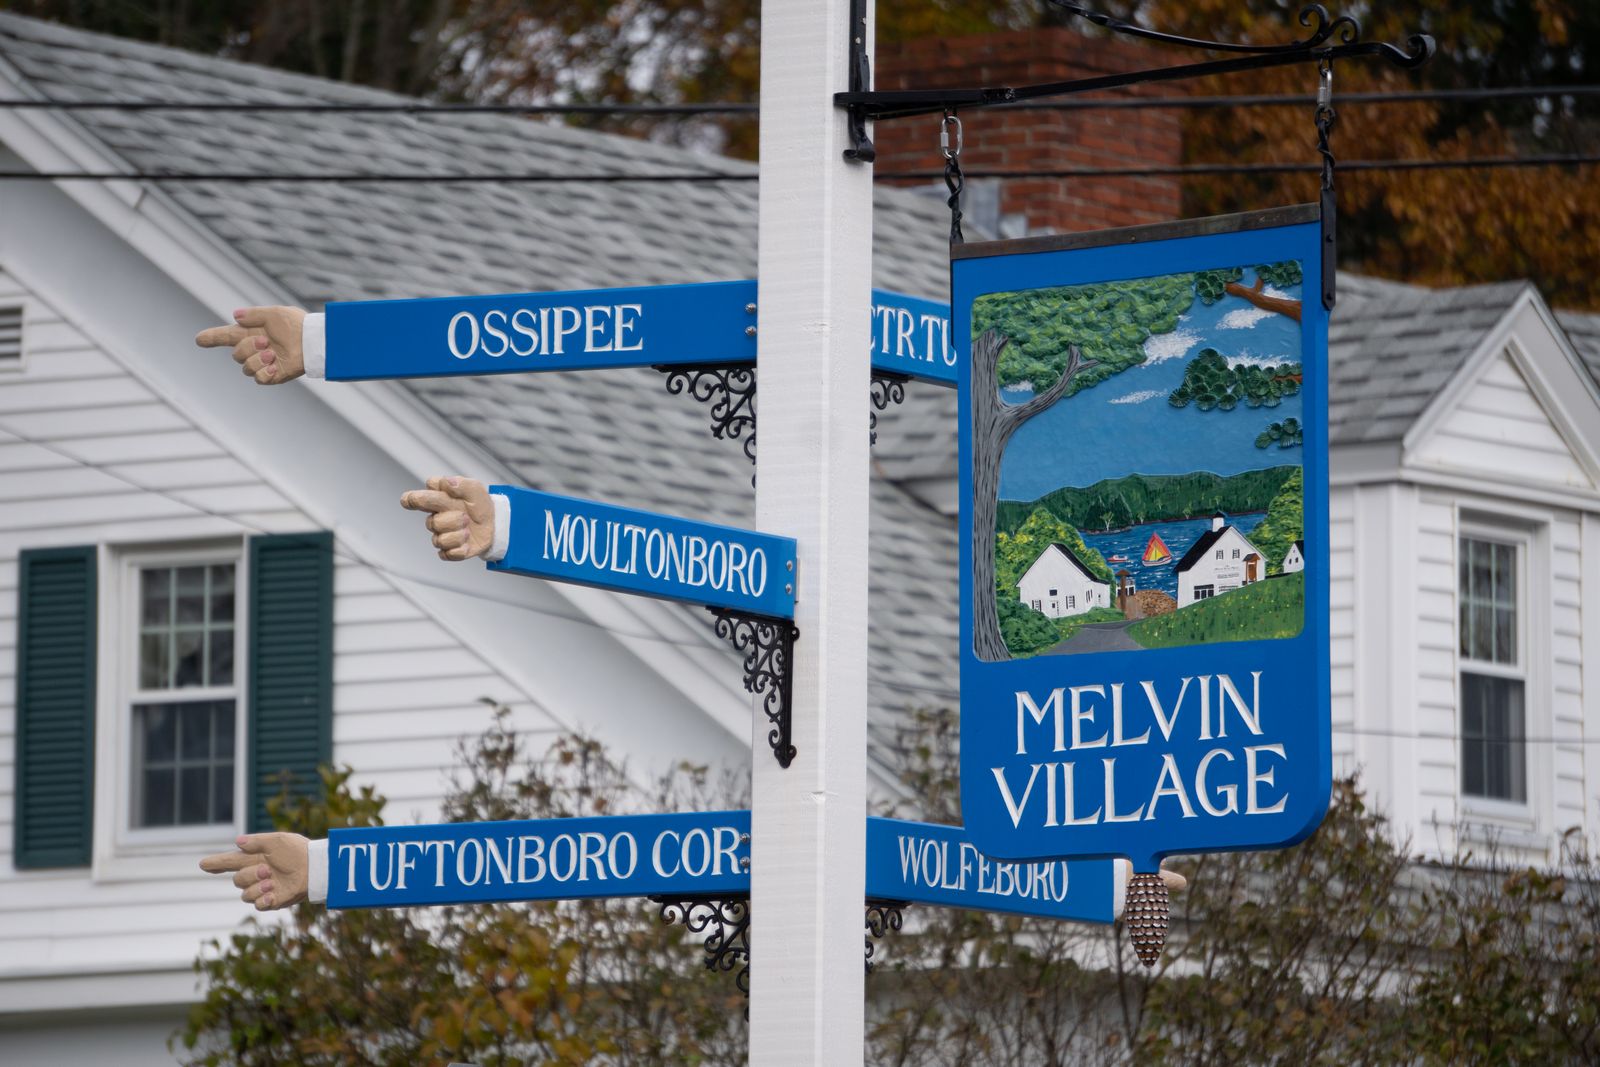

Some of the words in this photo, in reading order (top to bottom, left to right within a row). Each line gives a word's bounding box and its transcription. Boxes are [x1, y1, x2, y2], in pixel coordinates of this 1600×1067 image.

[447, 303, 644, 360] OSSIPEE
[542, 509, 768, 598] MOULTONBORO
[1014, 670, 1264, 755] MELVIN
[990, 743, 1289, 829] VILLAGE
[338, 831, 638, 892] TUFTONBORO
[898, 835, 1069, 903] WOLFEBORO
